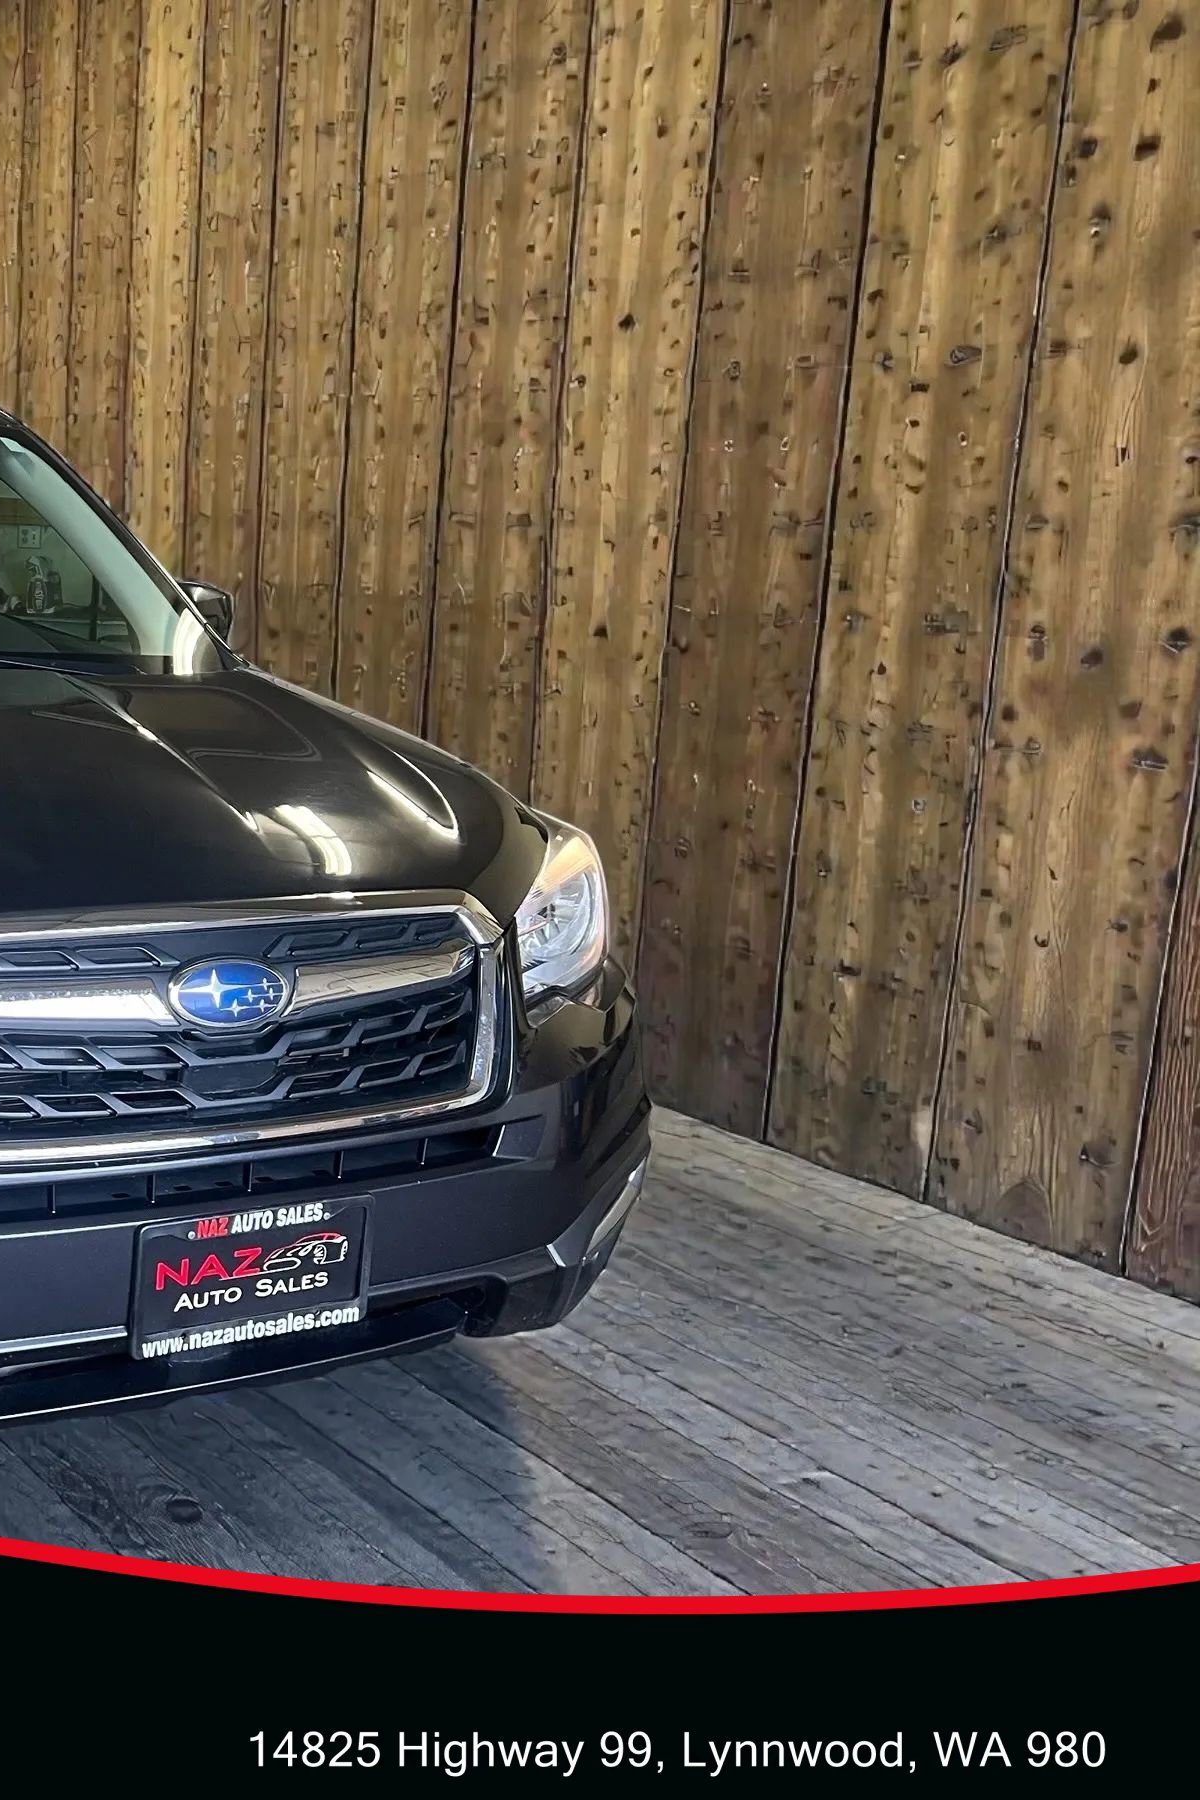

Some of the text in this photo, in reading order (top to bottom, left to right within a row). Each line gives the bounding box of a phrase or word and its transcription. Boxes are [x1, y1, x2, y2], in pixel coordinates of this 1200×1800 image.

[197, 1202, 324, 1238] NAZ AUTO SALES
[155, 1247, 263, 1291] NAZ
[173, 1271, 329, 1313] AUTO SALES
[141, 1305, 360, 1359] www.nazautosales.com
